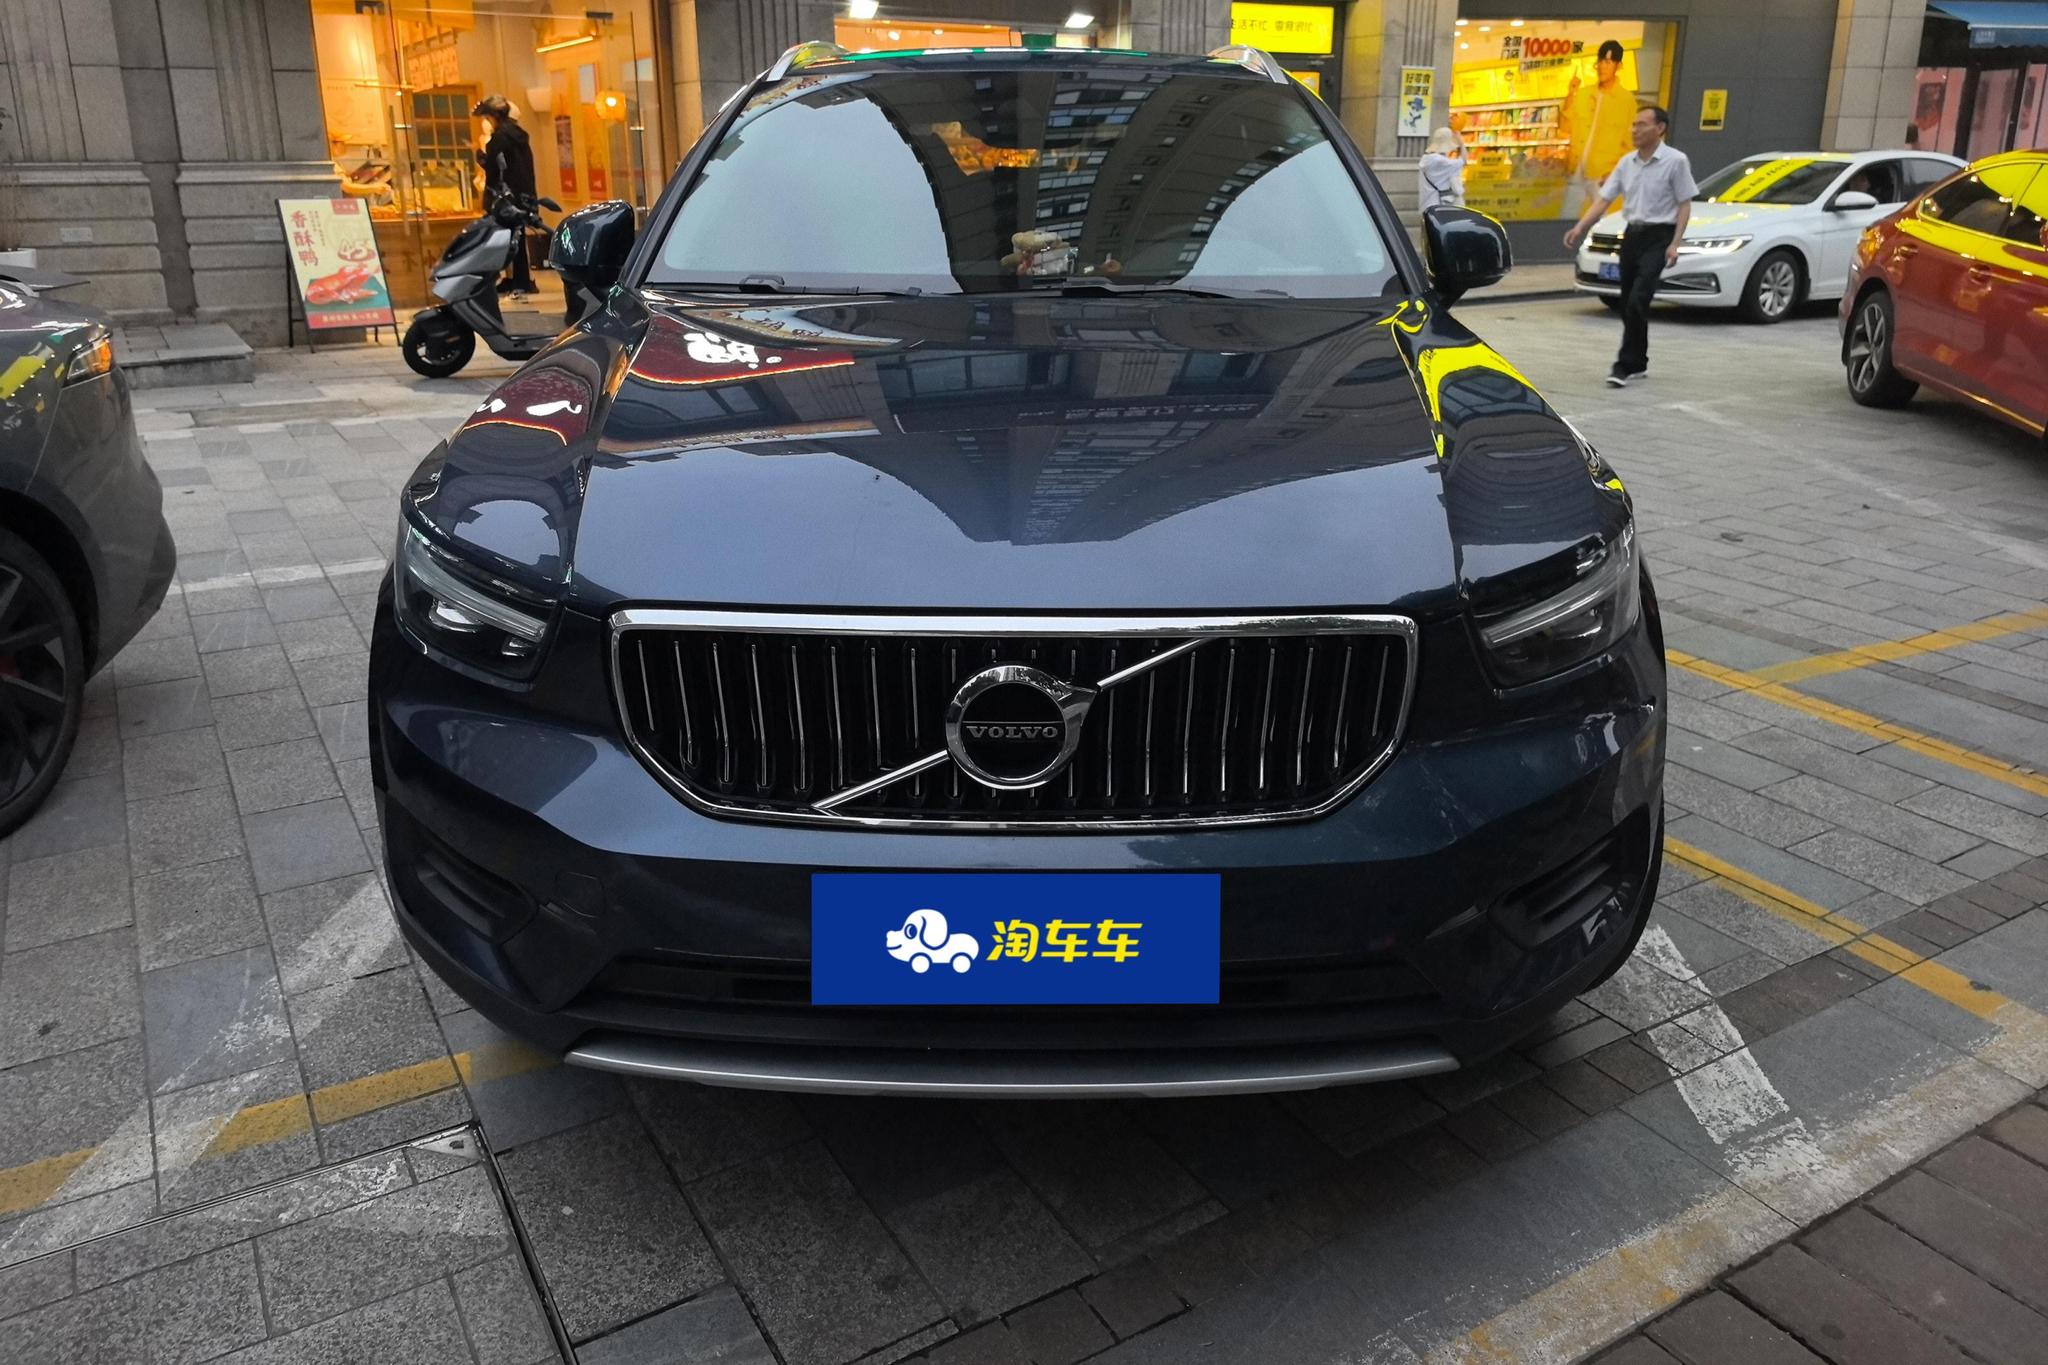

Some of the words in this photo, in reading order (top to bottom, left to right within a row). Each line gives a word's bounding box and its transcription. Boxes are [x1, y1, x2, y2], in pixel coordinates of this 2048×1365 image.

[291, 210, 319, 267] 香酥鸭
[966, 725, 1059, 739] VOLVO
